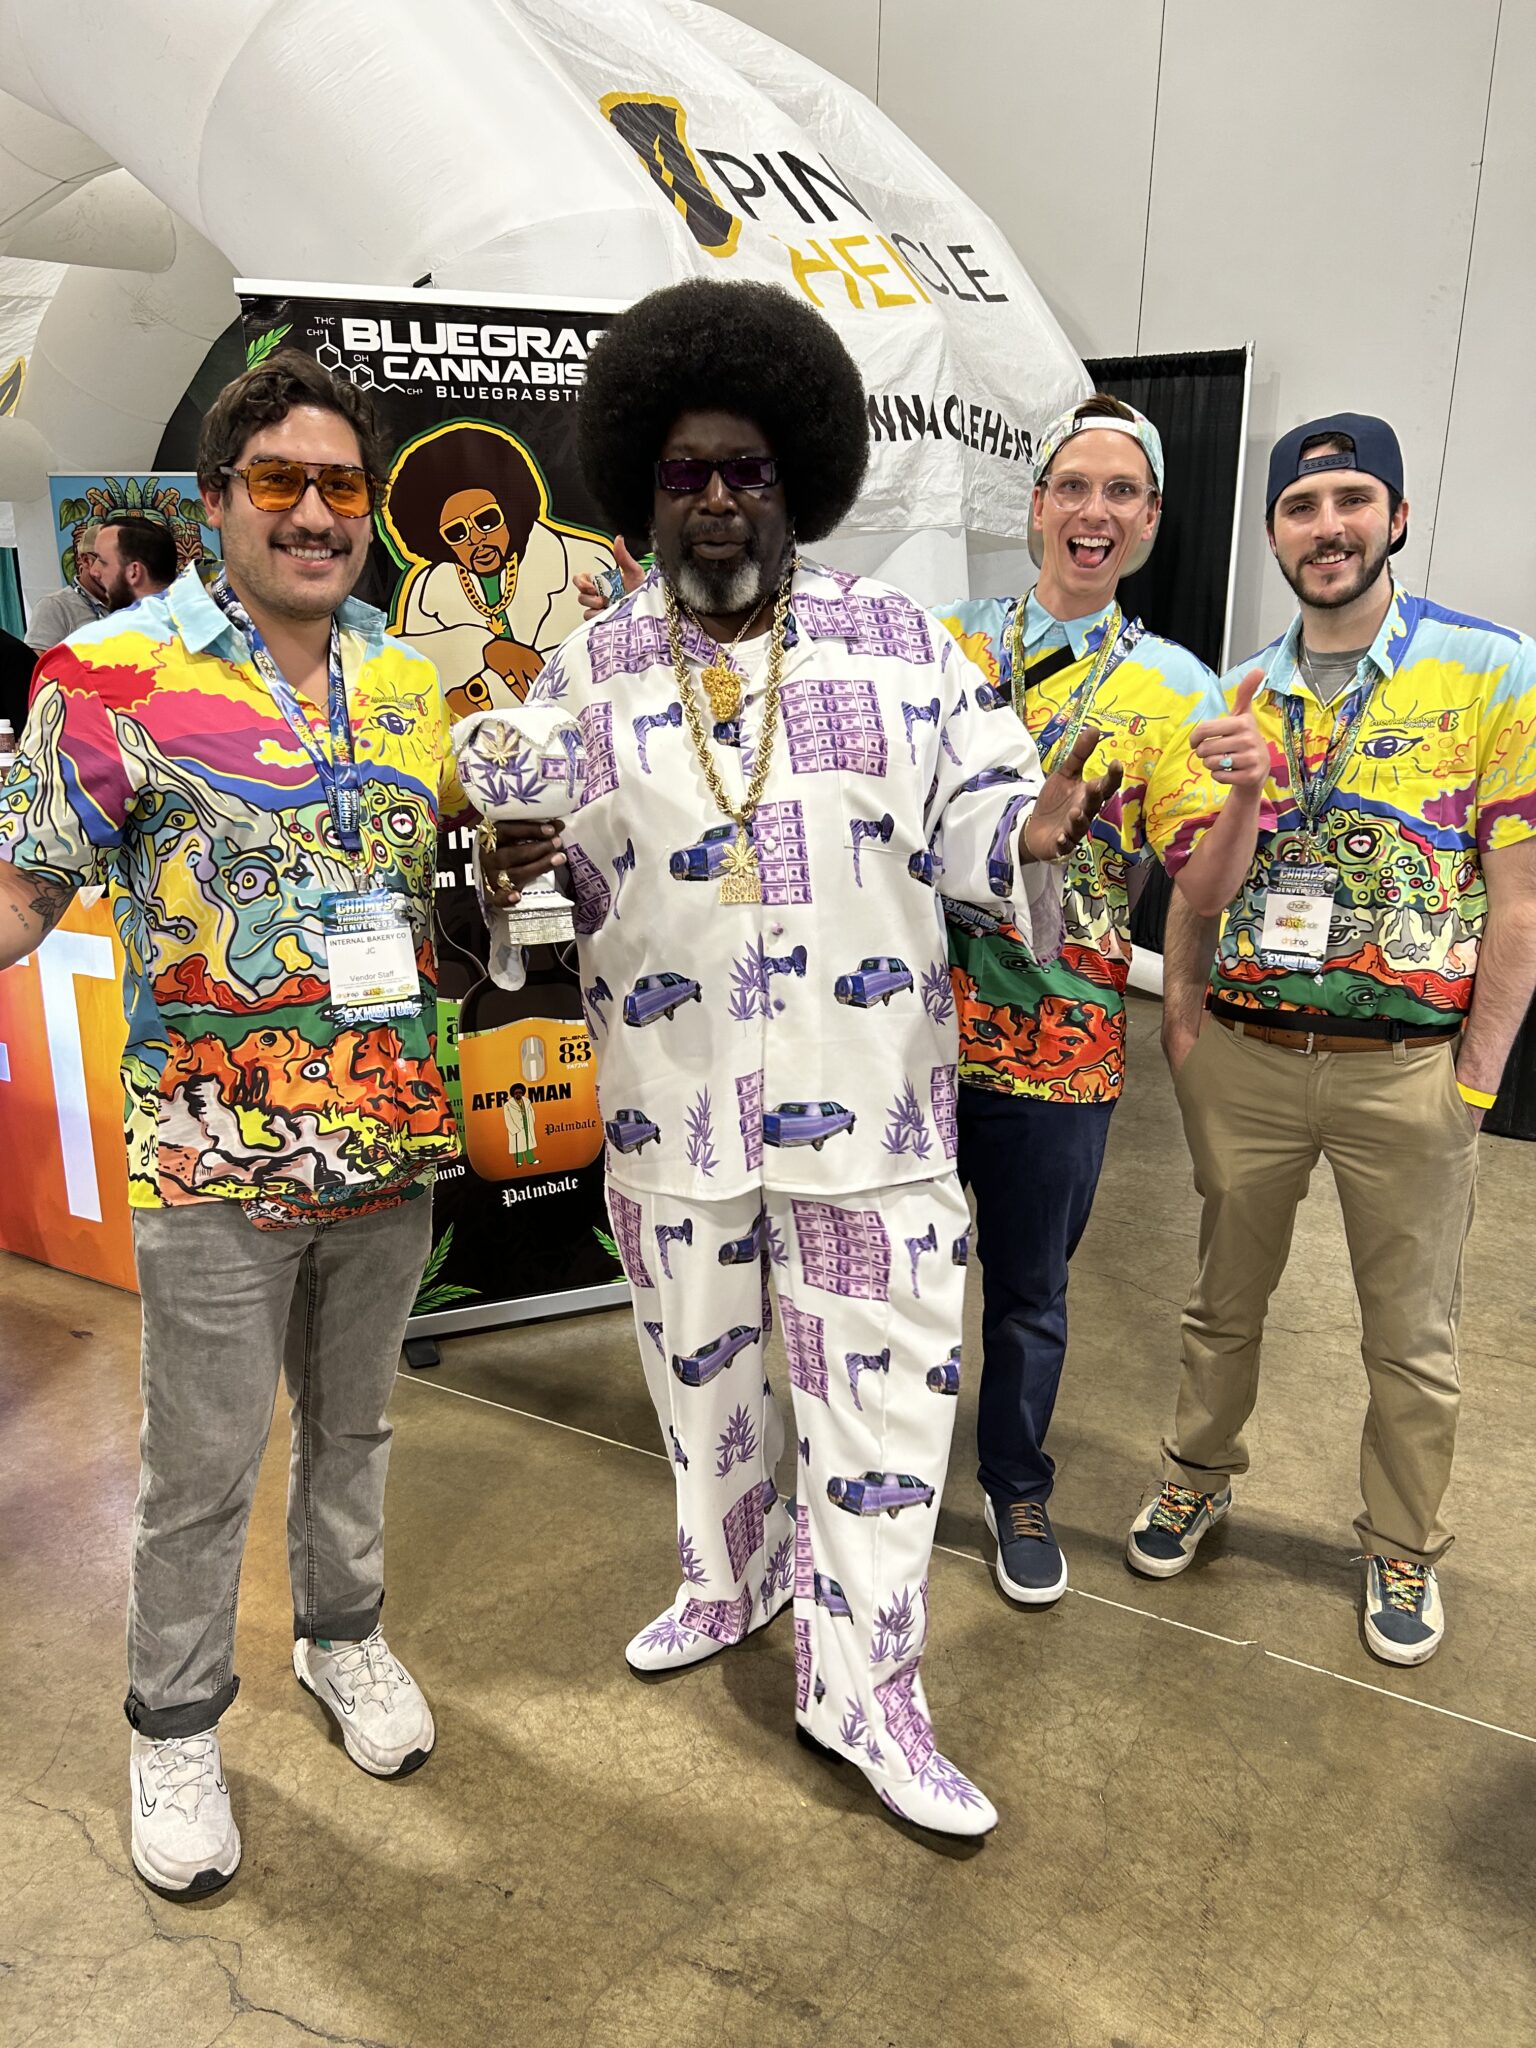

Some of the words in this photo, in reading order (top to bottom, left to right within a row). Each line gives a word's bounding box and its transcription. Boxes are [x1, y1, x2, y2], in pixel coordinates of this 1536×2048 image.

[314, 316, 336, 326] THC
[353, 354, 369, 363] OH
[383, 355, 588, 386] CANNABIS
[335, 680, 344, 707] HUSH
[338, 789, 352, 832] CHAMPS
[1280, 868, 1325, 881] CHAMPS
[336, 895, 393, 915] CHAMPS
[944, 899, 997, 930] EXHIBITOR
[336, 922, 375, 932] DENVER
[329, 938, 366, 947] INTERNAL
[366, 933, 395, 943] BAKERY
[365, 947, 376, 955] JC
[1267, 954, 1318, 970] EXHIBITOR
[349, 974, 376, 982] Vendor
[377, 970, 394, 979] Staff
[344, 1001, 414, 1022] EXHIBITOR
[559, 1041, 592, 1063] 83
[545, 1119, 598, 1136] Palmdale
[501, 1176, 579, 1208] Palmdale
